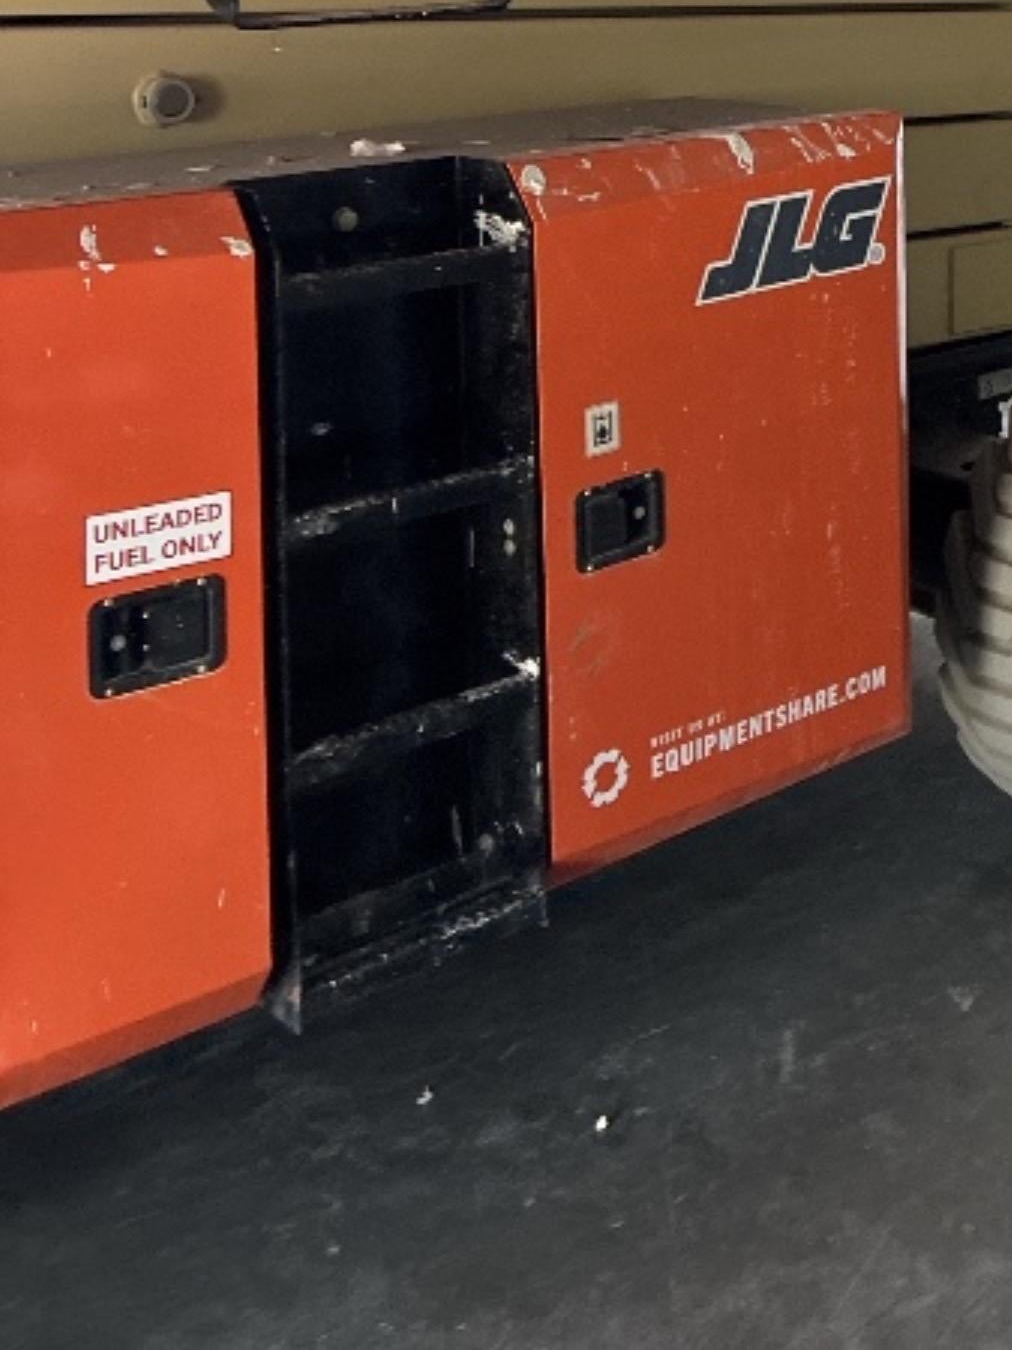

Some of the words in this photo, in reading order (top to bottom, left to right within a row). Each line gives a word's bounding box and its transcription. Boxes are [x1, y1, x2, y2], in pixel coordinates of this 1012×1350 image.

[694, 174, 893, 307] JLG
[93, 502, 222, 544] UNLEADED
[94, 545, 154, 573] FUEL
[161, 530, 222, 559] ONLY
[651, 665, 887, 779] EQUIPMENTSHARE.COM
